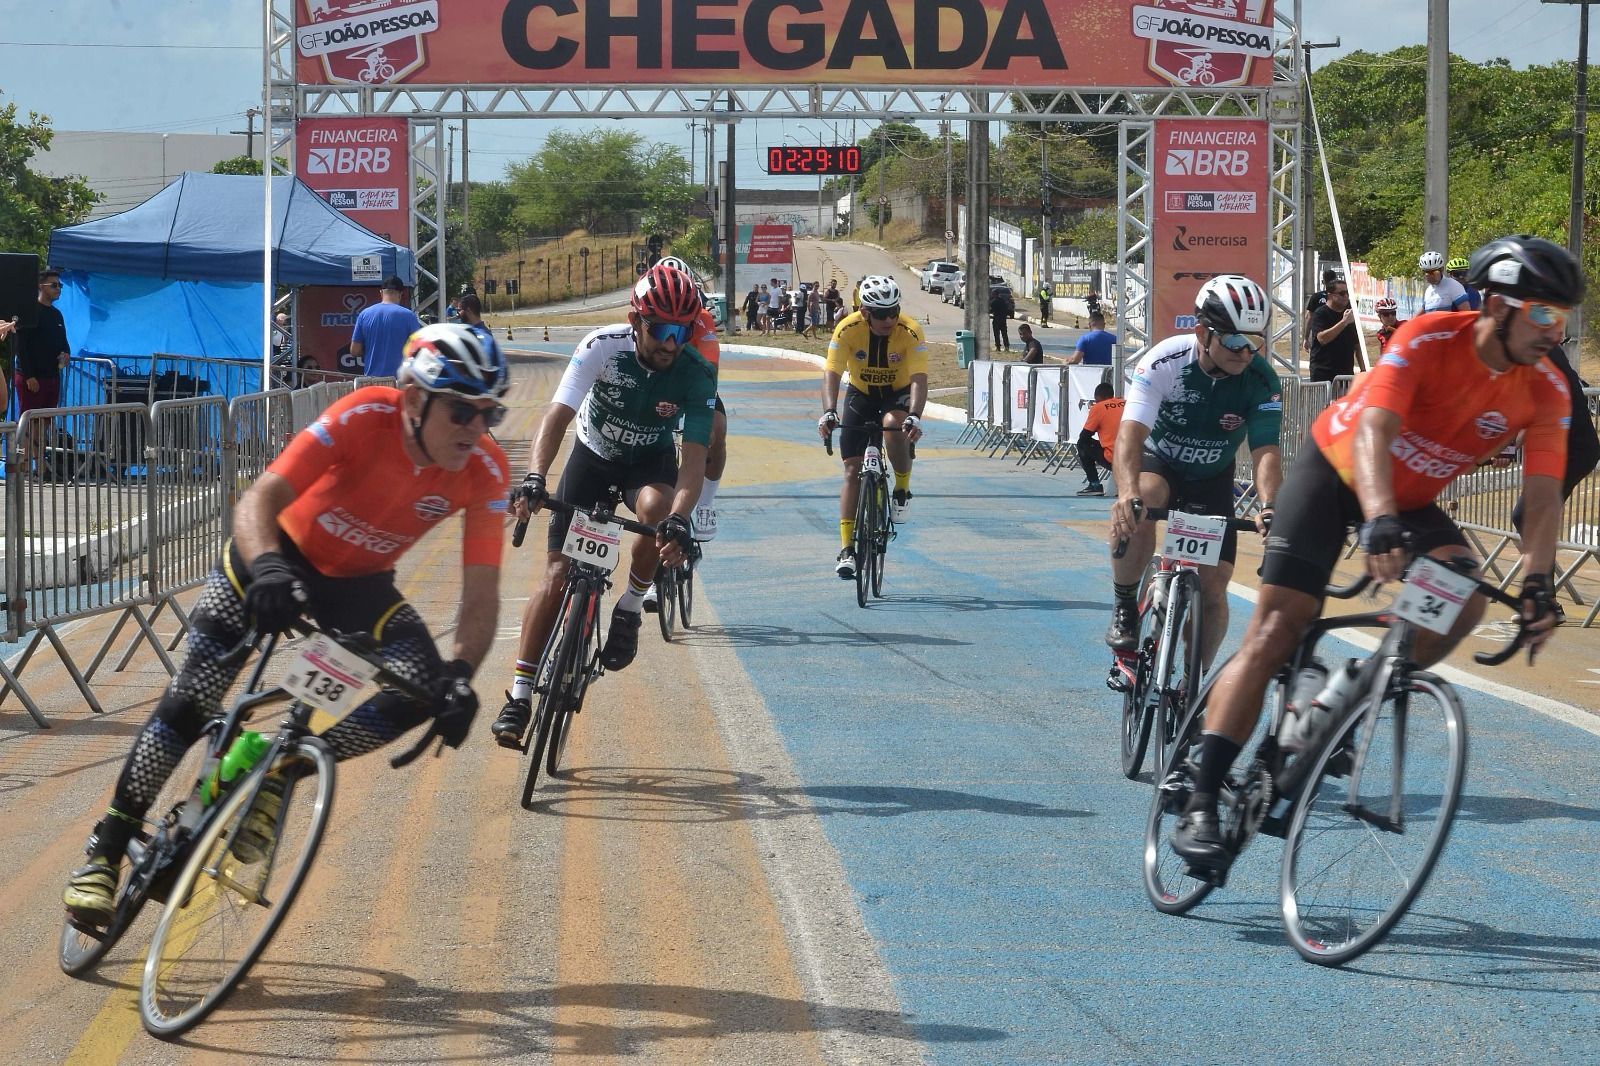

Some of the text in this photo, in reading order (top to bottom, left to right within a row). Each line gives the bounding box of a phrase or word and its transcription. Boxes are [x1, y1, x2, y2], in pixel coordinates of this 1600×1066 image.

[369, 10, 436, 36] PESSOA
[501, 0, 1068, 70] CHEGADA
[1206, 25, 1271, 51] PESSOA
[310, 128, 398, 144] FINANCEIRA
[1169, 131, 1257, 146] FINANCEIRA
[336, 148, 391, 175] BRB
[770, 149, 859, 172] 02:29:10
[1195, 150, 1249, 176] BRB
[1188, 200, 1212, 208] PESSOA
[1188, 235, 1247, 247] energisa
[606, 414, 666, 433] FINANCEIRA
[621, 430, 661, 447] BRB
[1164, 431, 1229, 447] FINANCEIRA
[1179, 446, 1223, 465] BRB
[1406, 451, 1461, 479] BRB
[342, 528, 401, 554] BRB
[575, 536, 609, 558] 190
[1175, 537, 1209, 556] 101
[1418, 595, 1446, 619] 34
[304, 669, 345, 702] 138
